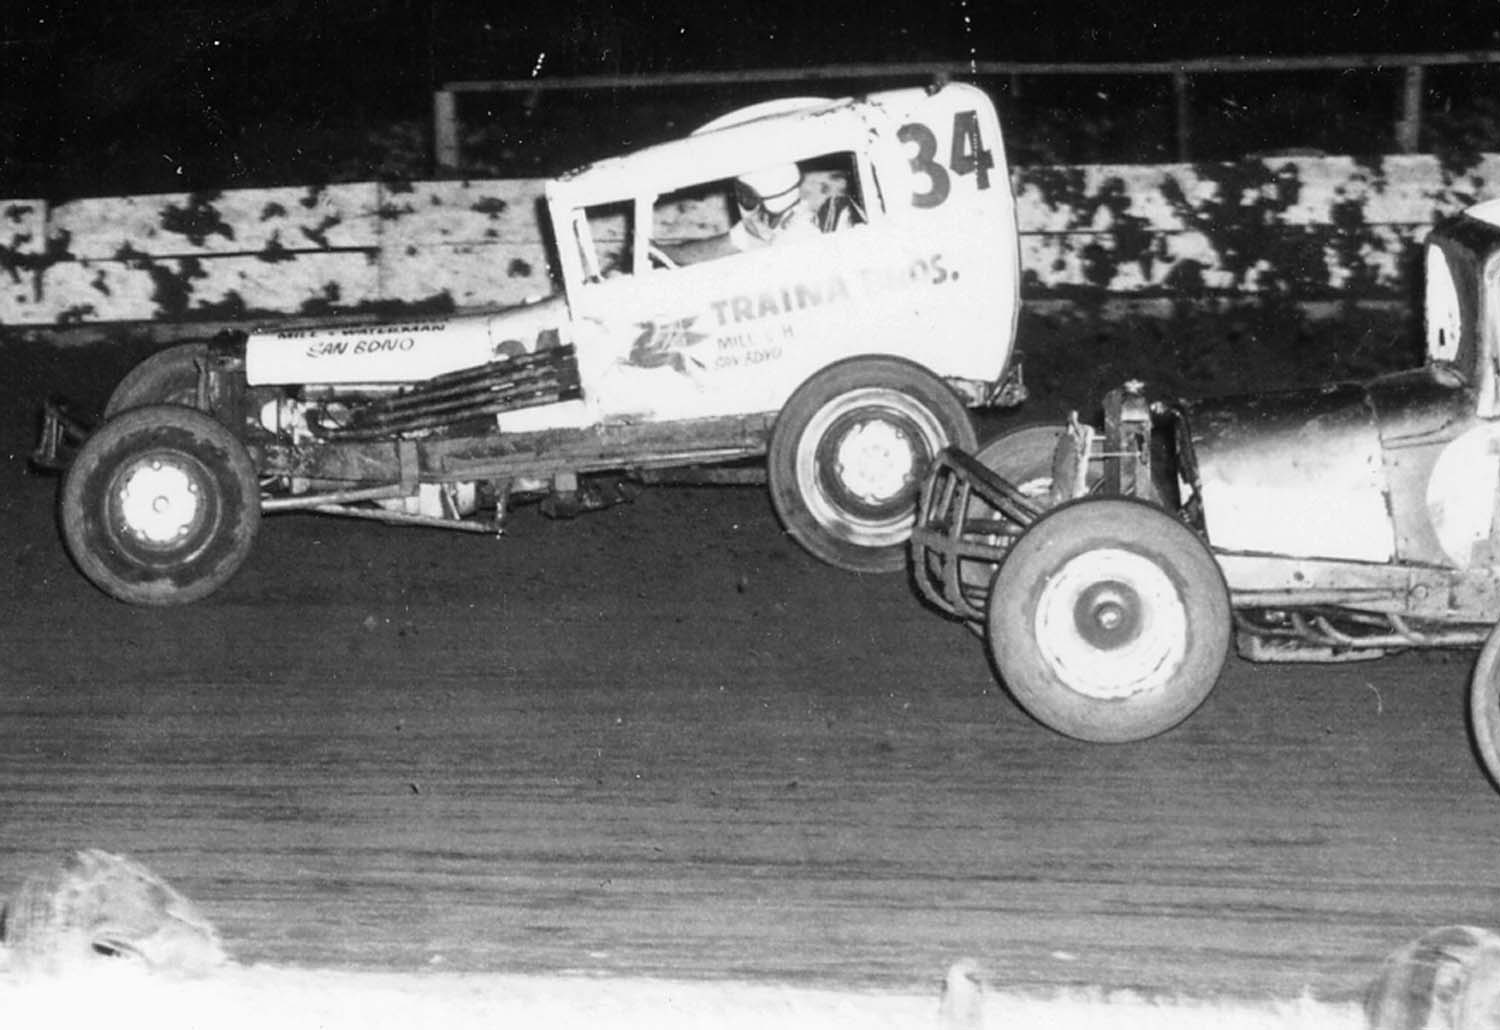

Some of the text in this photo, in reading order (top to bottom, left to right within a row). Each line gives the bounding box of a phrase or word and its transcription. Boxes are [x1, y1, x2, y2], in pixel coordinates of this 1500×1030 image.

[896, 110, 995, 209] 34
[710, 274, 850, 326] TRAINA
[306, 341, 348, 358] SAN
